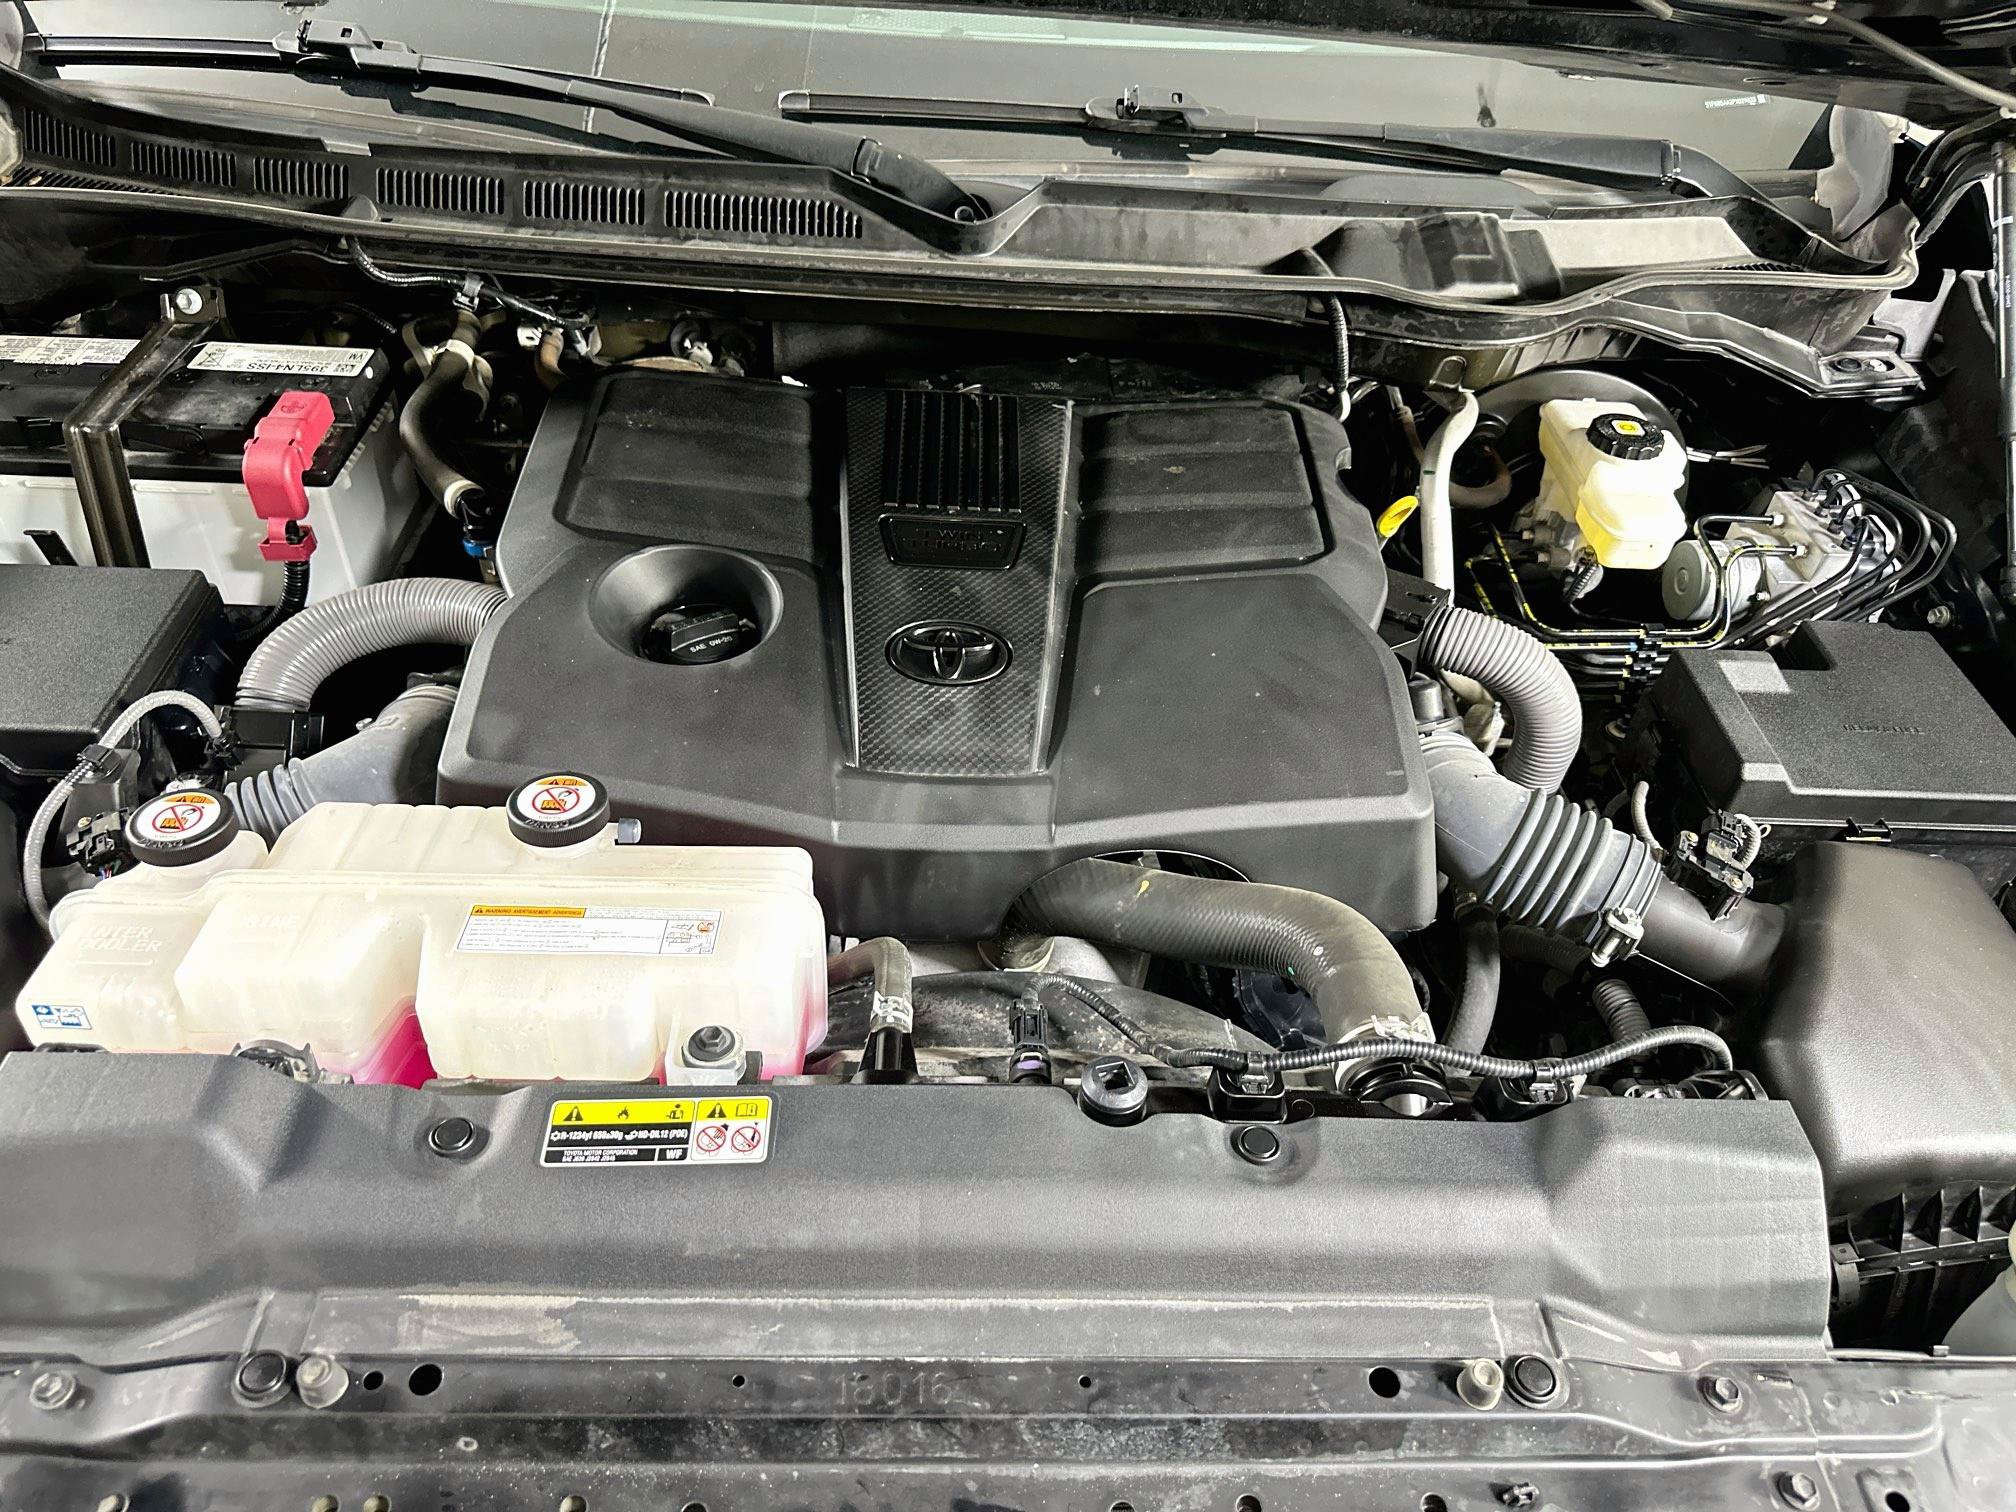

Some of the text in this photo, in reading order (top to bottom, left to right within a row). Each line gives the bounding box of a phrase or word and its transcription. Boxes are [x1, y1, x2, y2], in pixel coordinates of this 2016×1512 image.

[690, 636, 733, 653] SAE 0W-20
[665, 1149, 683, 1159] WF
